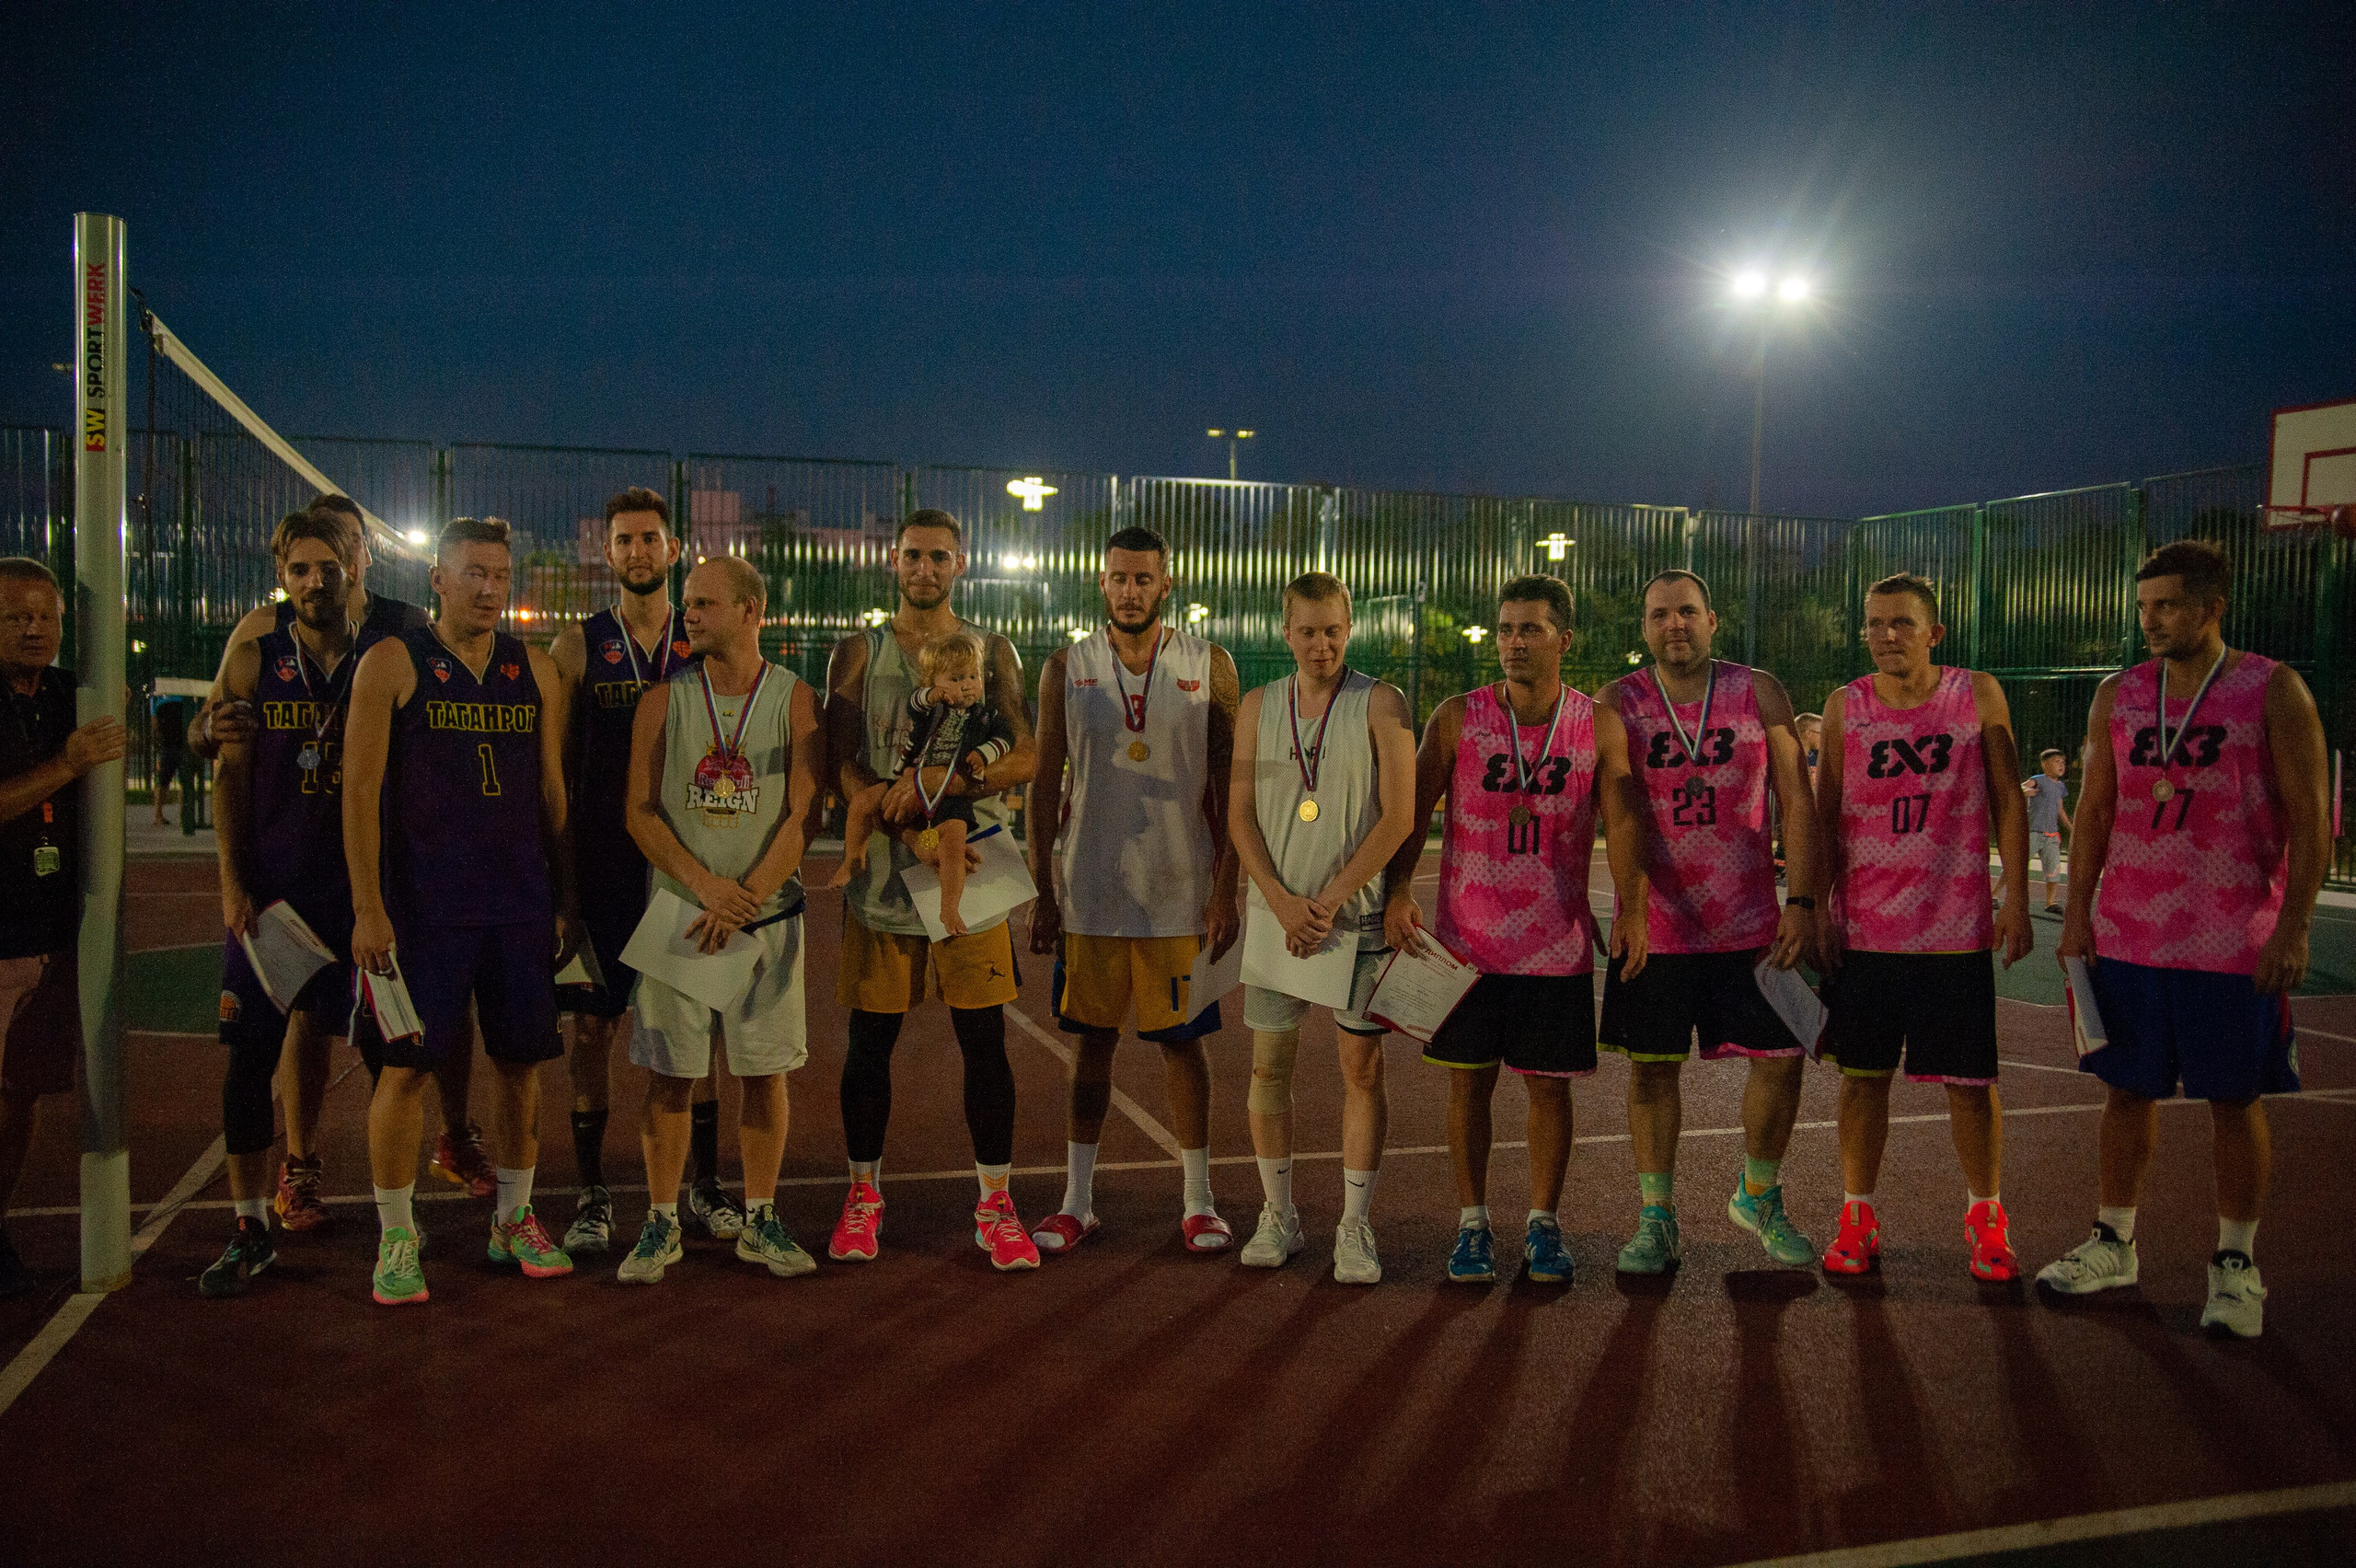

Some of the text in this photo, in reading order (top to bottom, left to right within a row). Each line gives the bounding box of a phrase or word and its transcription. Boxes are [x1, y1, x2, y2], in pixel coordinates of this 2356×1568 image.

[86, 407, 106, 453] SW
[478, 744, 502, 797] 1
[686, 783, 760, 814] REIGN
[1672, 786, 1715, 826] 23
[1892, 793, 1932, 834] 07
[1425, 948, 1458, 971] ДИПЛОМ
